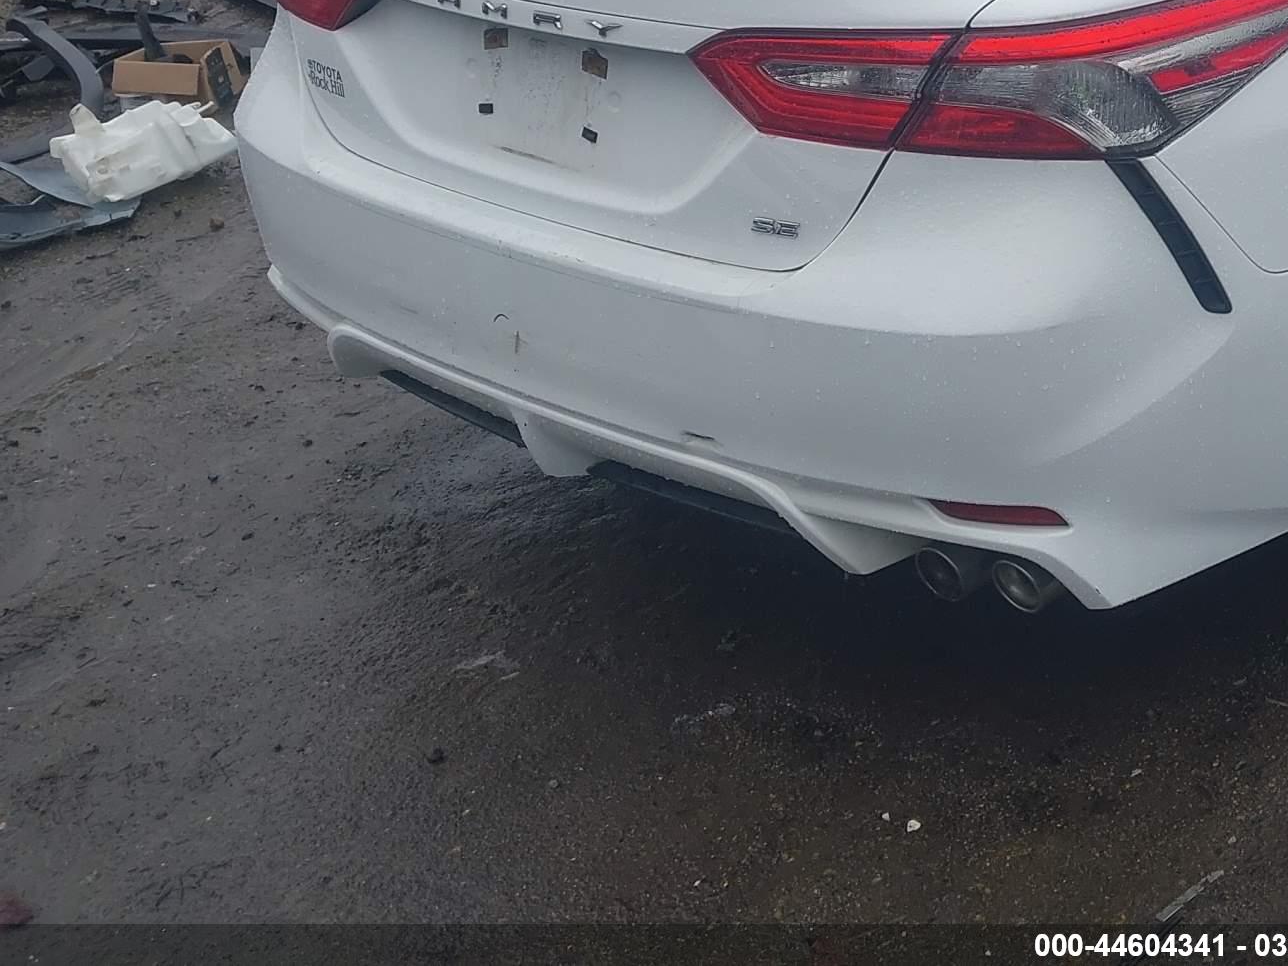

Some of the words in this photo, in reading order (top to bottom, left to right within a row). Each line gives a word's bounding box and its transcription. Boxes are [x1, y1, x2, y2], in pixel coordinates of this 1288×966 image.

[312, 60, 343, 83] TOYOTA
[308, 70, 331, 94] Rock
[330, 79, 346, 98] Hill
[751, 216, 801, 240] SE
